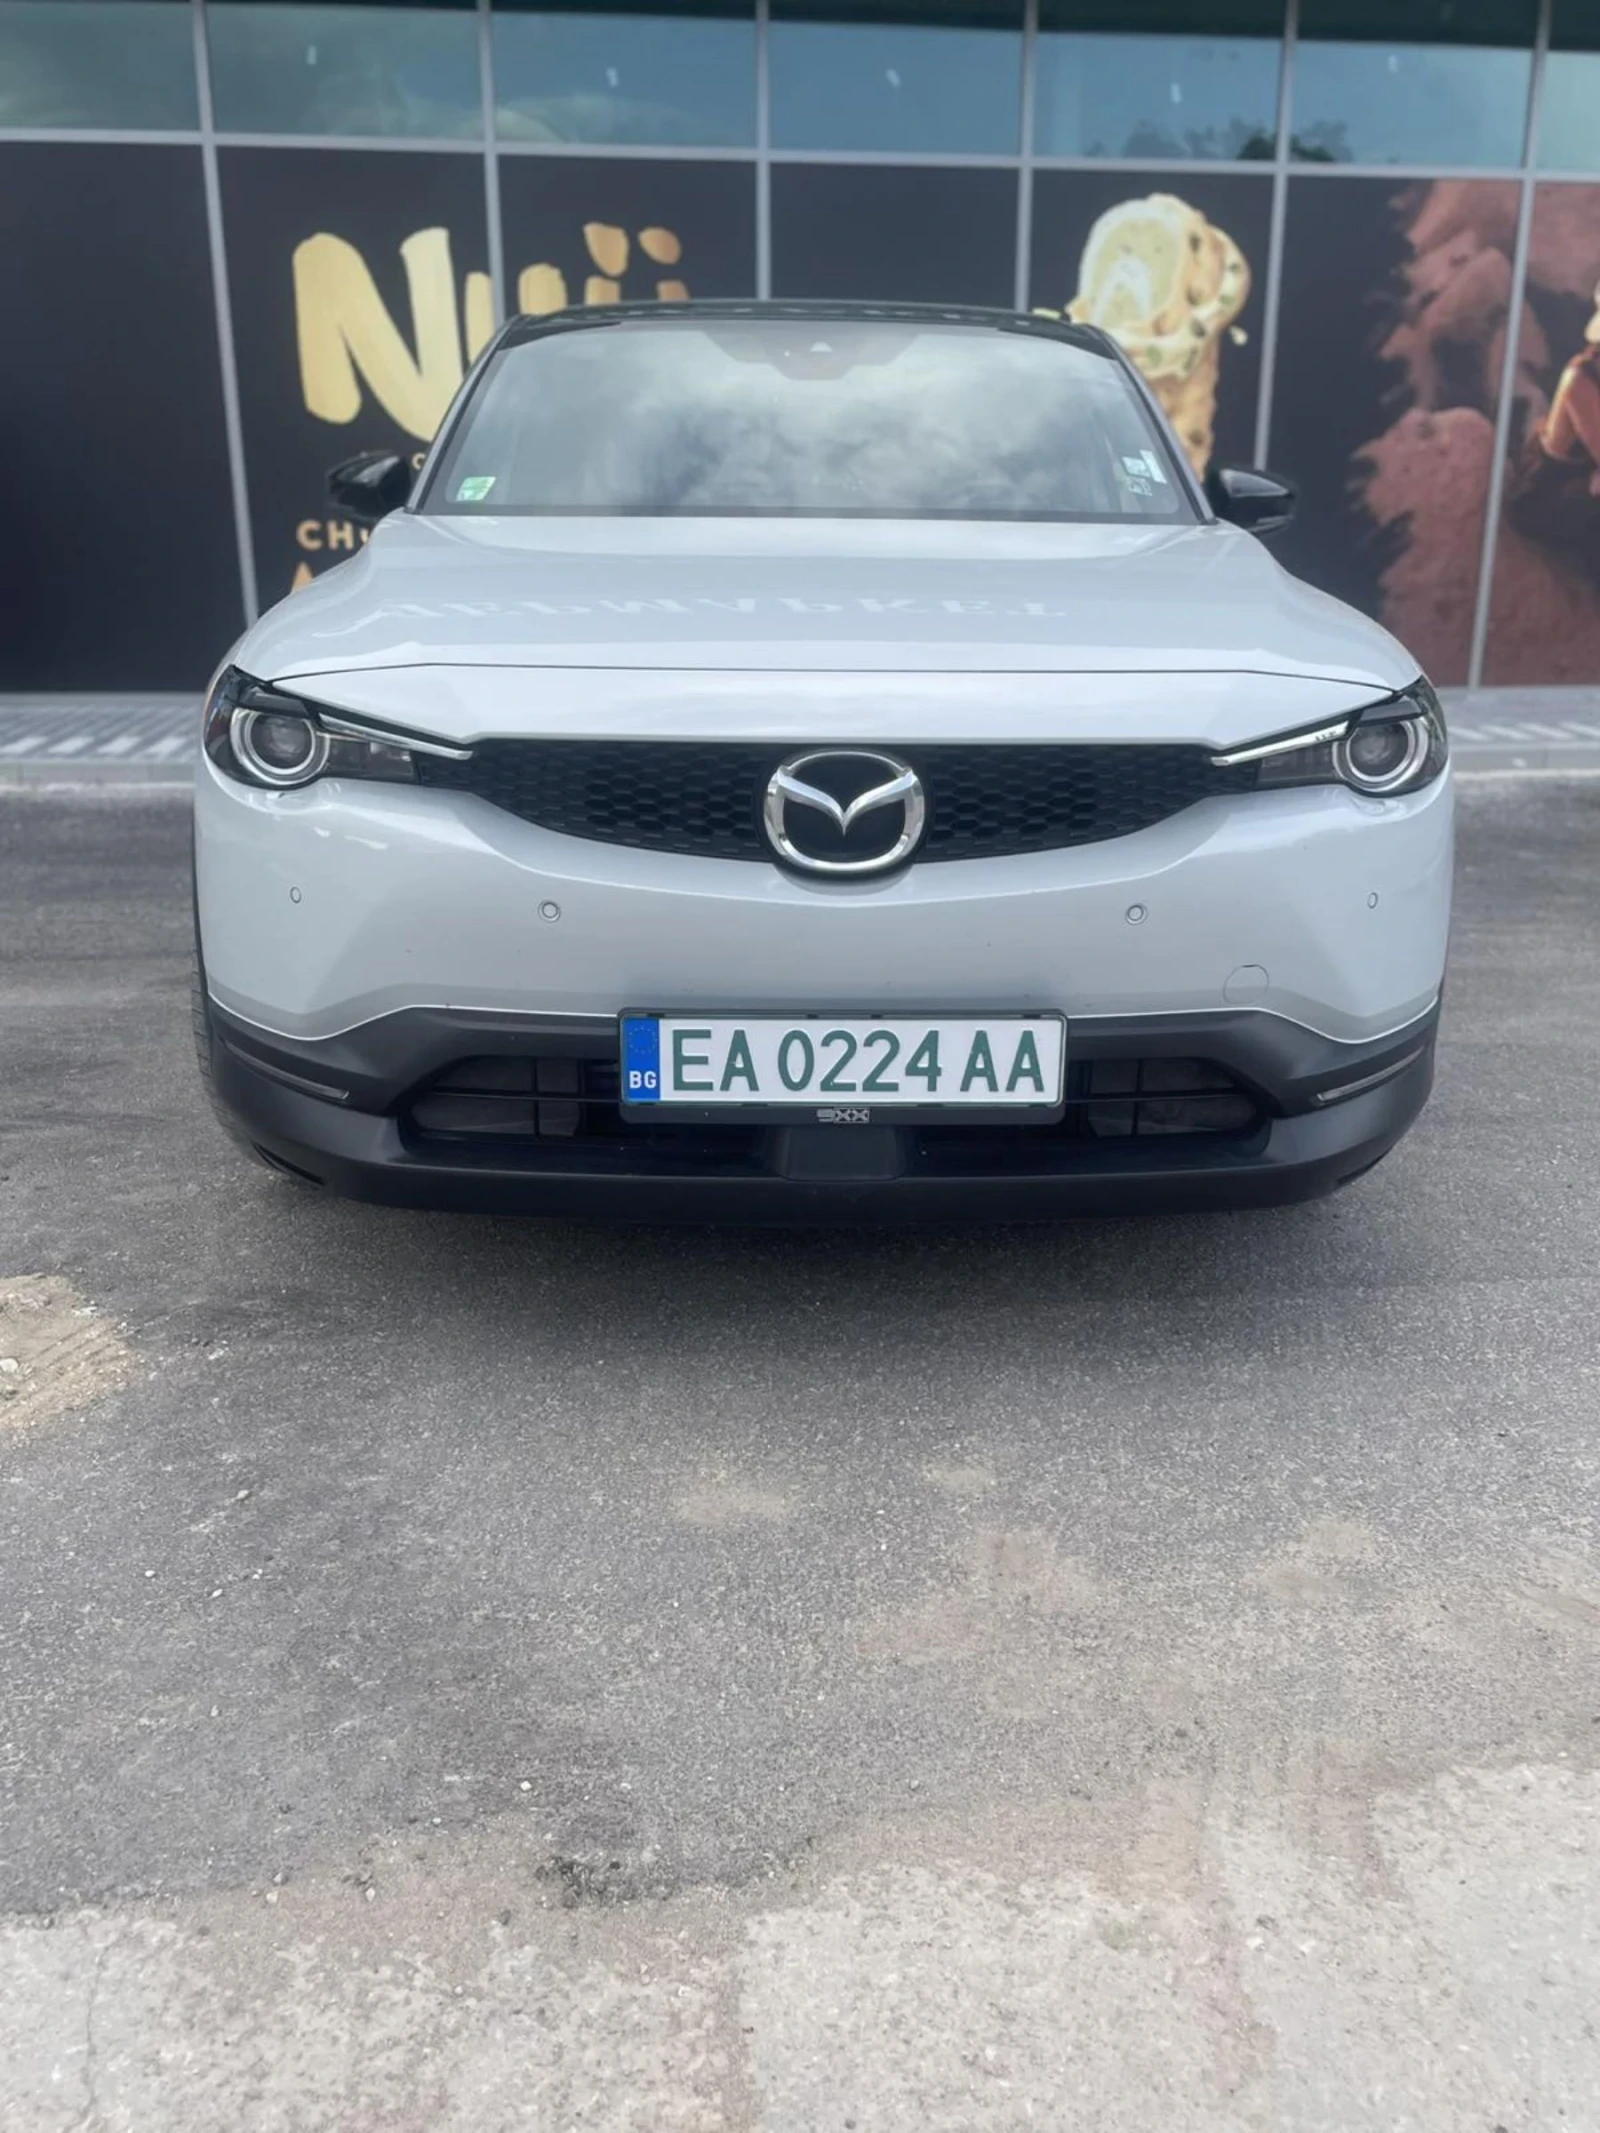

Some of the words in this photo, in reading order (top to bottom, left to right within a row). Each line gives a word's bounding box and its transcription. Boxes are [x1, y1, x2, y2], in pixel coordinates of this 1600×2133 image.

[628, 1070, 657, 1090] BG
[672, 1028, 760, 1092] EA
[777, 1028, 942, 1093] 0224
[959, 1029, 1045, 1093] AA
